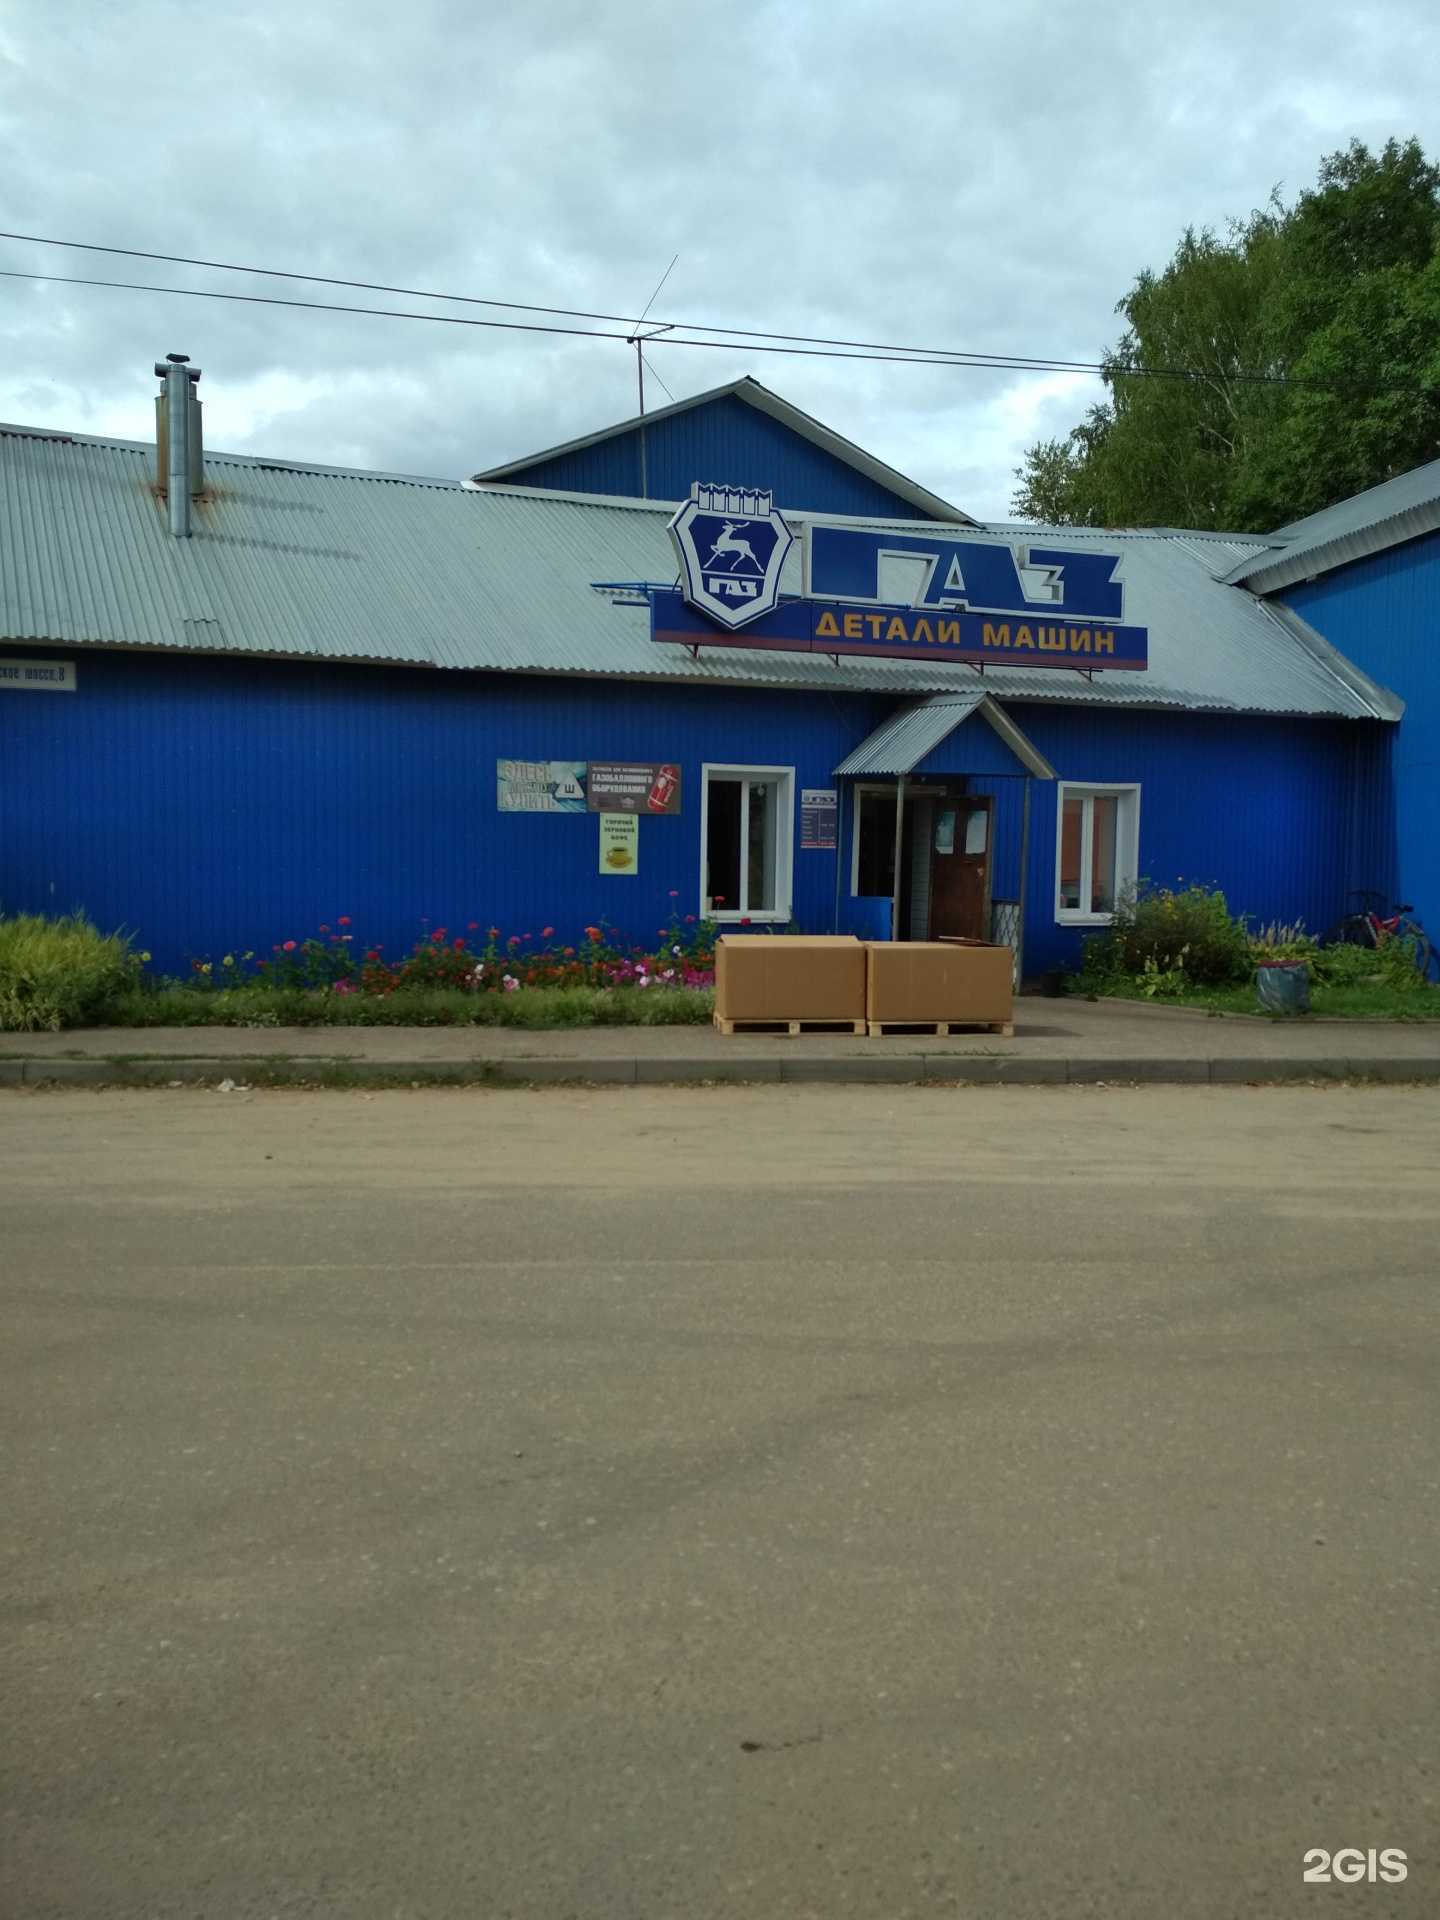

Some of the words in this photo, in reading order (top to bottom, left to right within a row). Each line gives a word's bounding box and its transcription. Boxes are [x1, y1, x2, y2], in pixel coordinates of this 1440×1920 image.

[708, 577, 757, 597] ГАЗ
[805, 522, 1125, 622] ГАЗ
[815, 611, 960, 645] ДЕТАЛИ
[982, 622, 1114, 654] МАШИН
